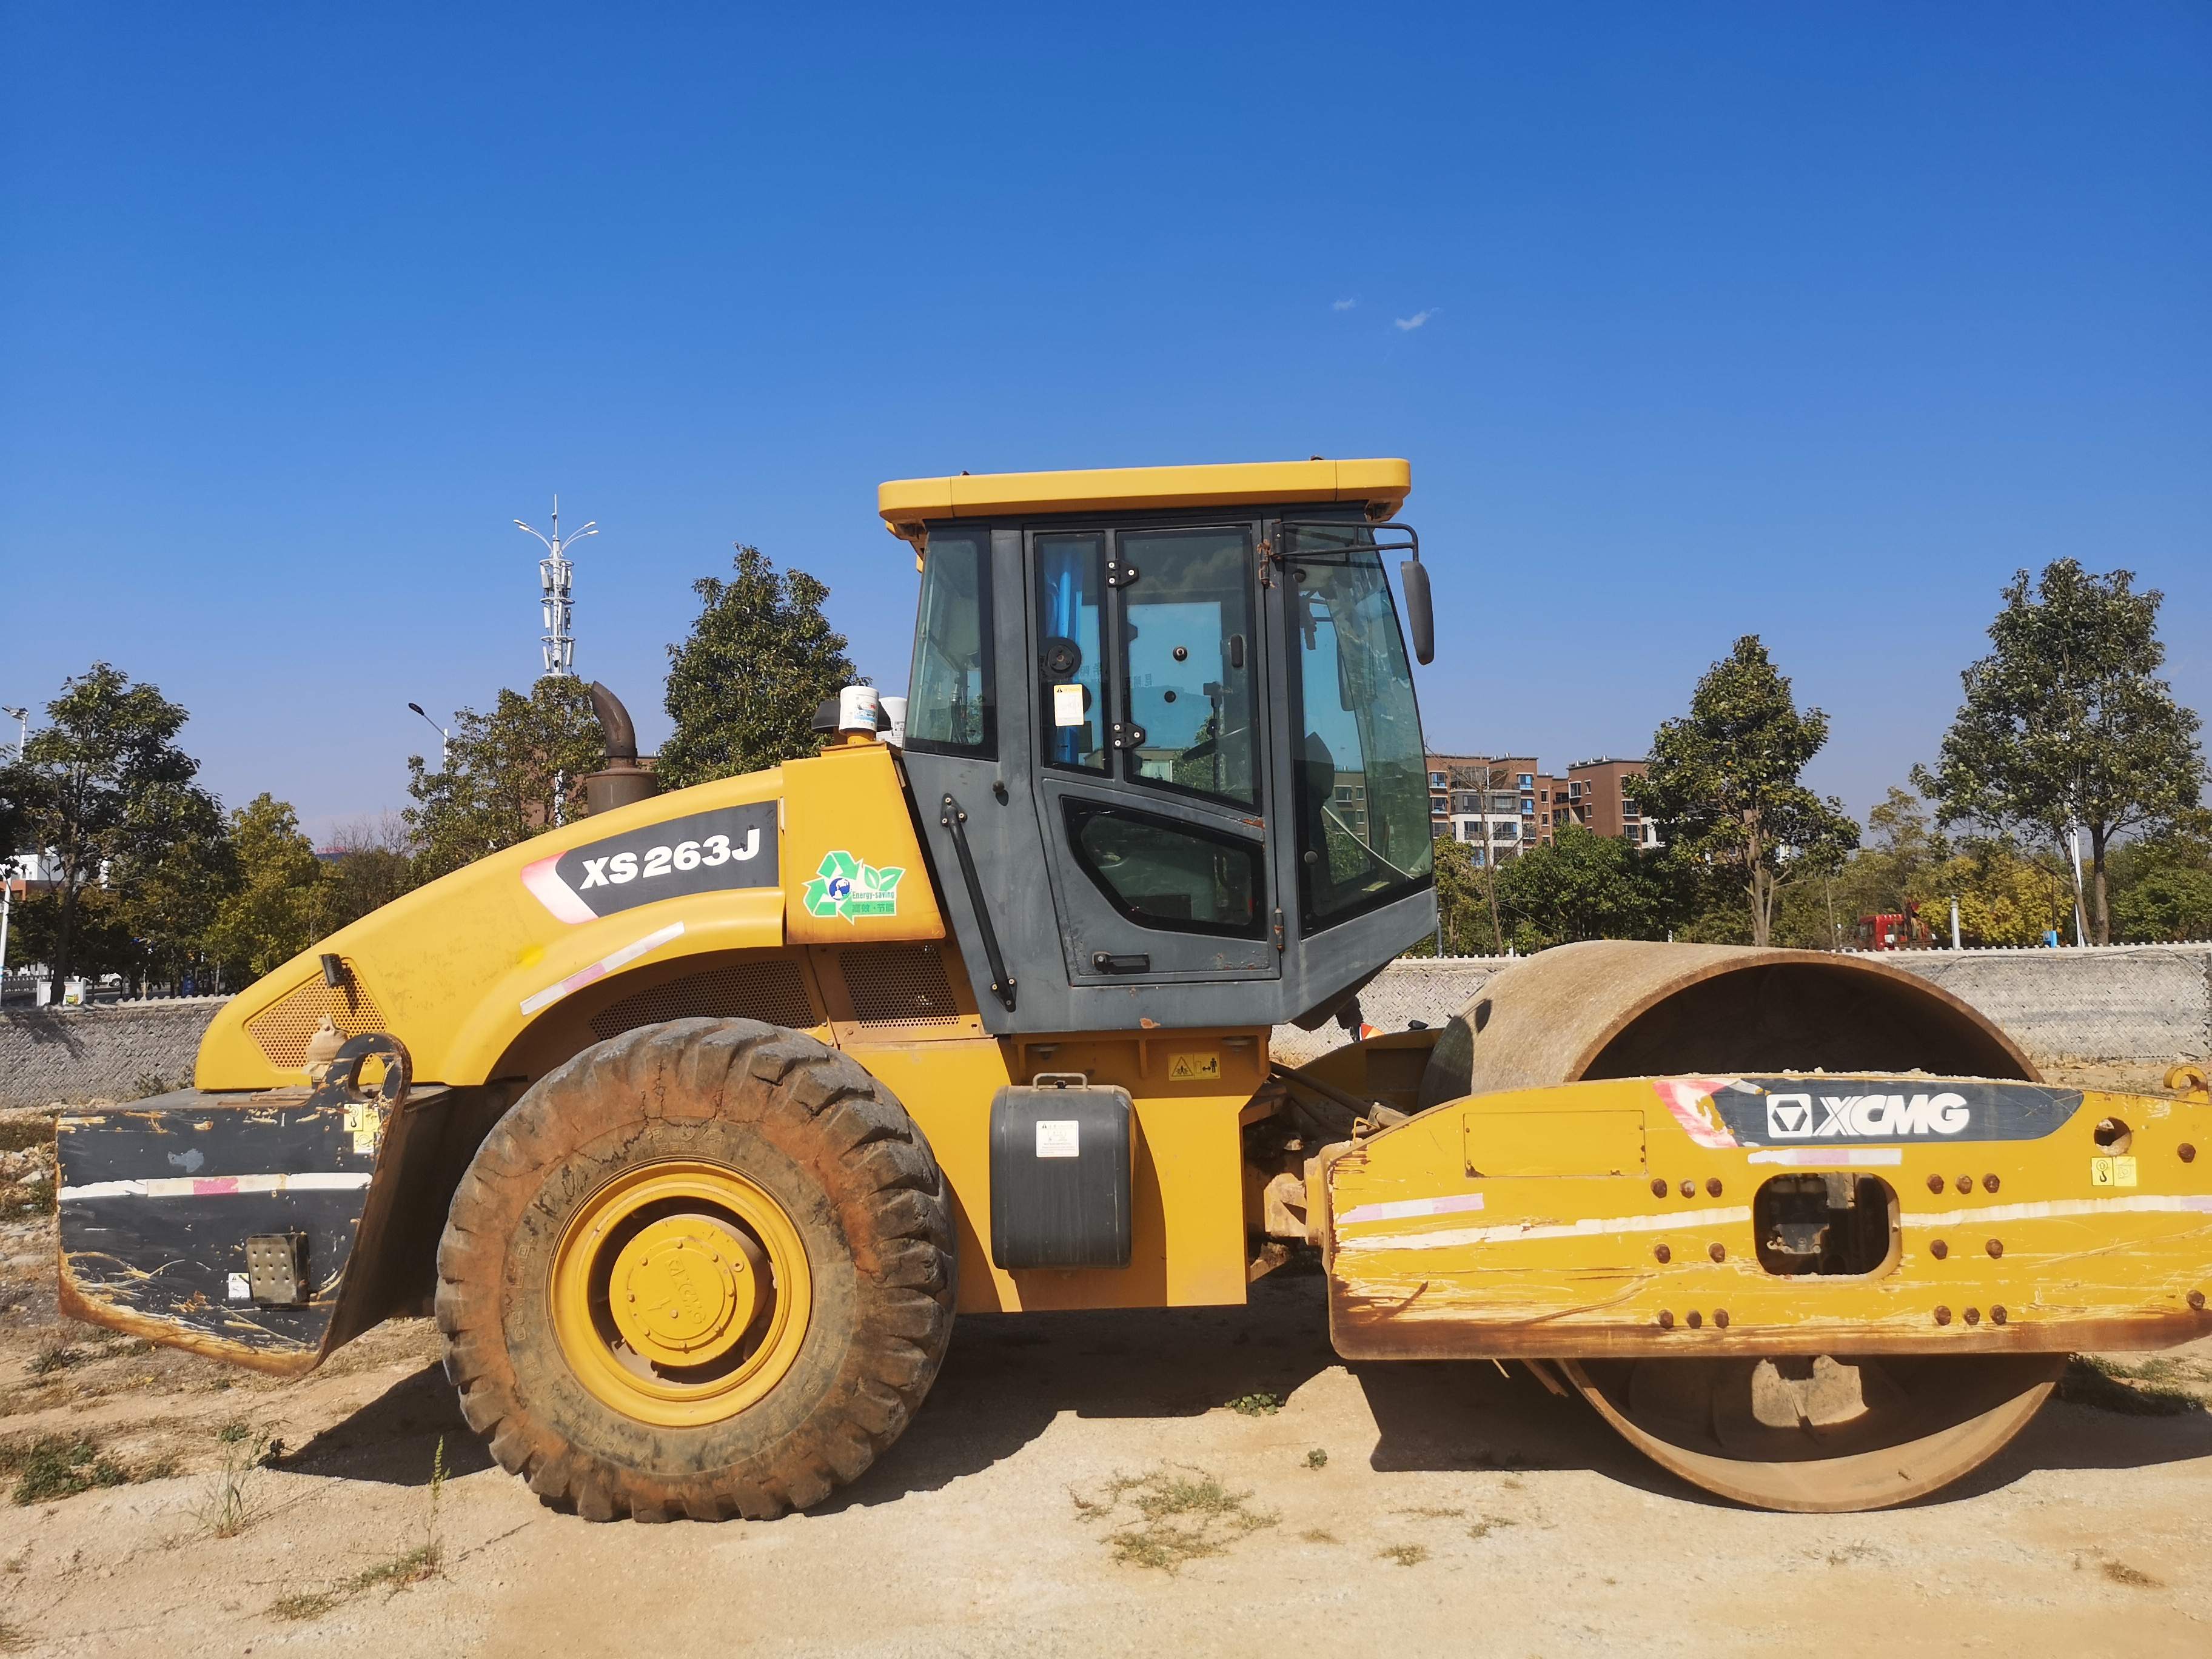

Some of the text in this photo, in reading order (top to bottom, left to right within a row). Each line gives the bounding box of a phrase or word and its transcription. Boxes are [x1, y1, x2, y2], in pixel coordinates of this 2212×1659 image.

[579, 828, 760, 890] XS263J
[852, 891, 894, 900] Energy-saving
[1812, 1093, 1969, 1136] XCMG
